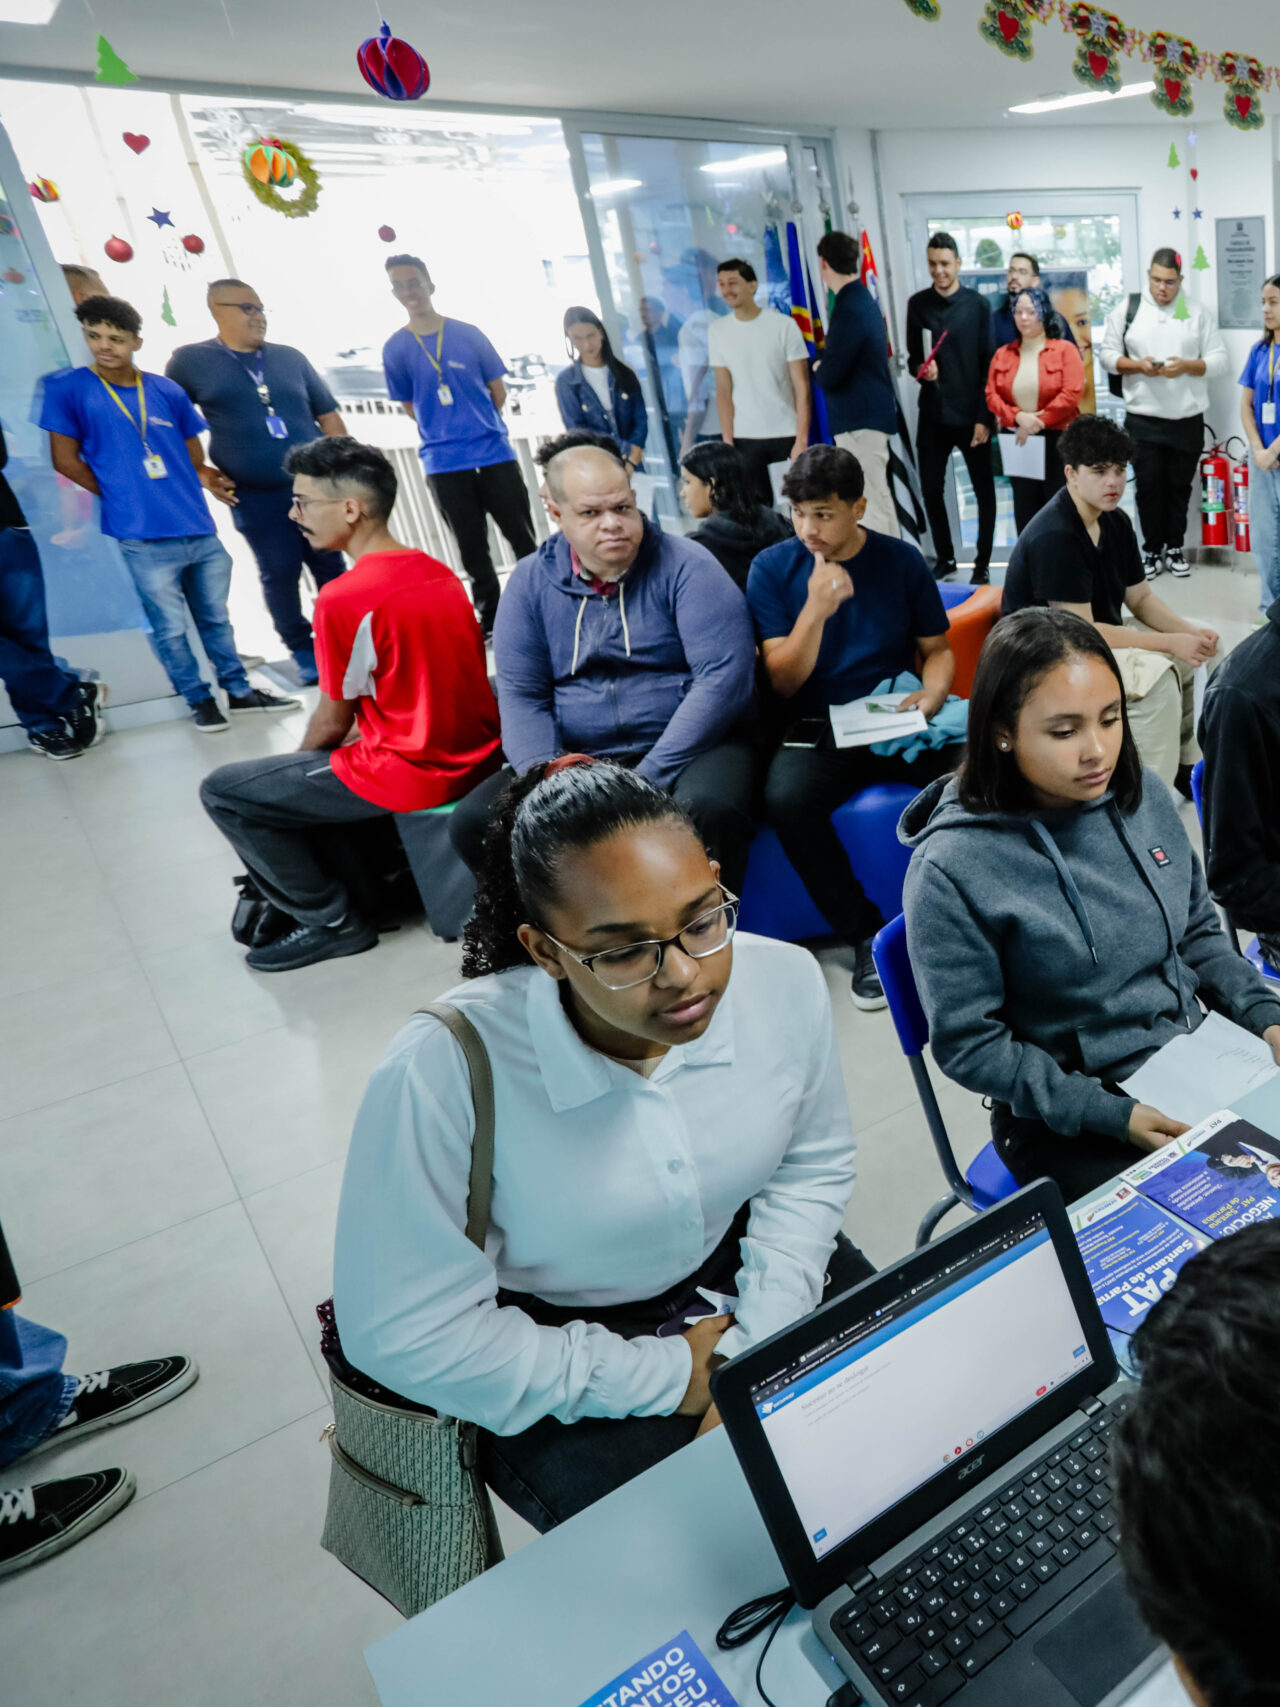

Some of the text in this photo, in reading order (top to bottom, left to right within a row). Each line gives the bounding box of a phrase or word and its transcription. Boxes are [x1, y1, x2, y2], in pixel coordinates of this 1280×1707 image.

[1229, 1197, 1240, 1208] de
[1241, 1196, 1256, 1207] PAT
[1208, 1206, 1238, 1229] Santana
[1144, 1239, 1193, 1275] Santana
[1129, 1271, 1147, 1284] de
[1121, 1267, 1178, 1317] PAT
[958, 1454, 985, 1480] acer
[598, 1647, 684, 1707] TANDO
[666, 1678, 707, 1707] EU
